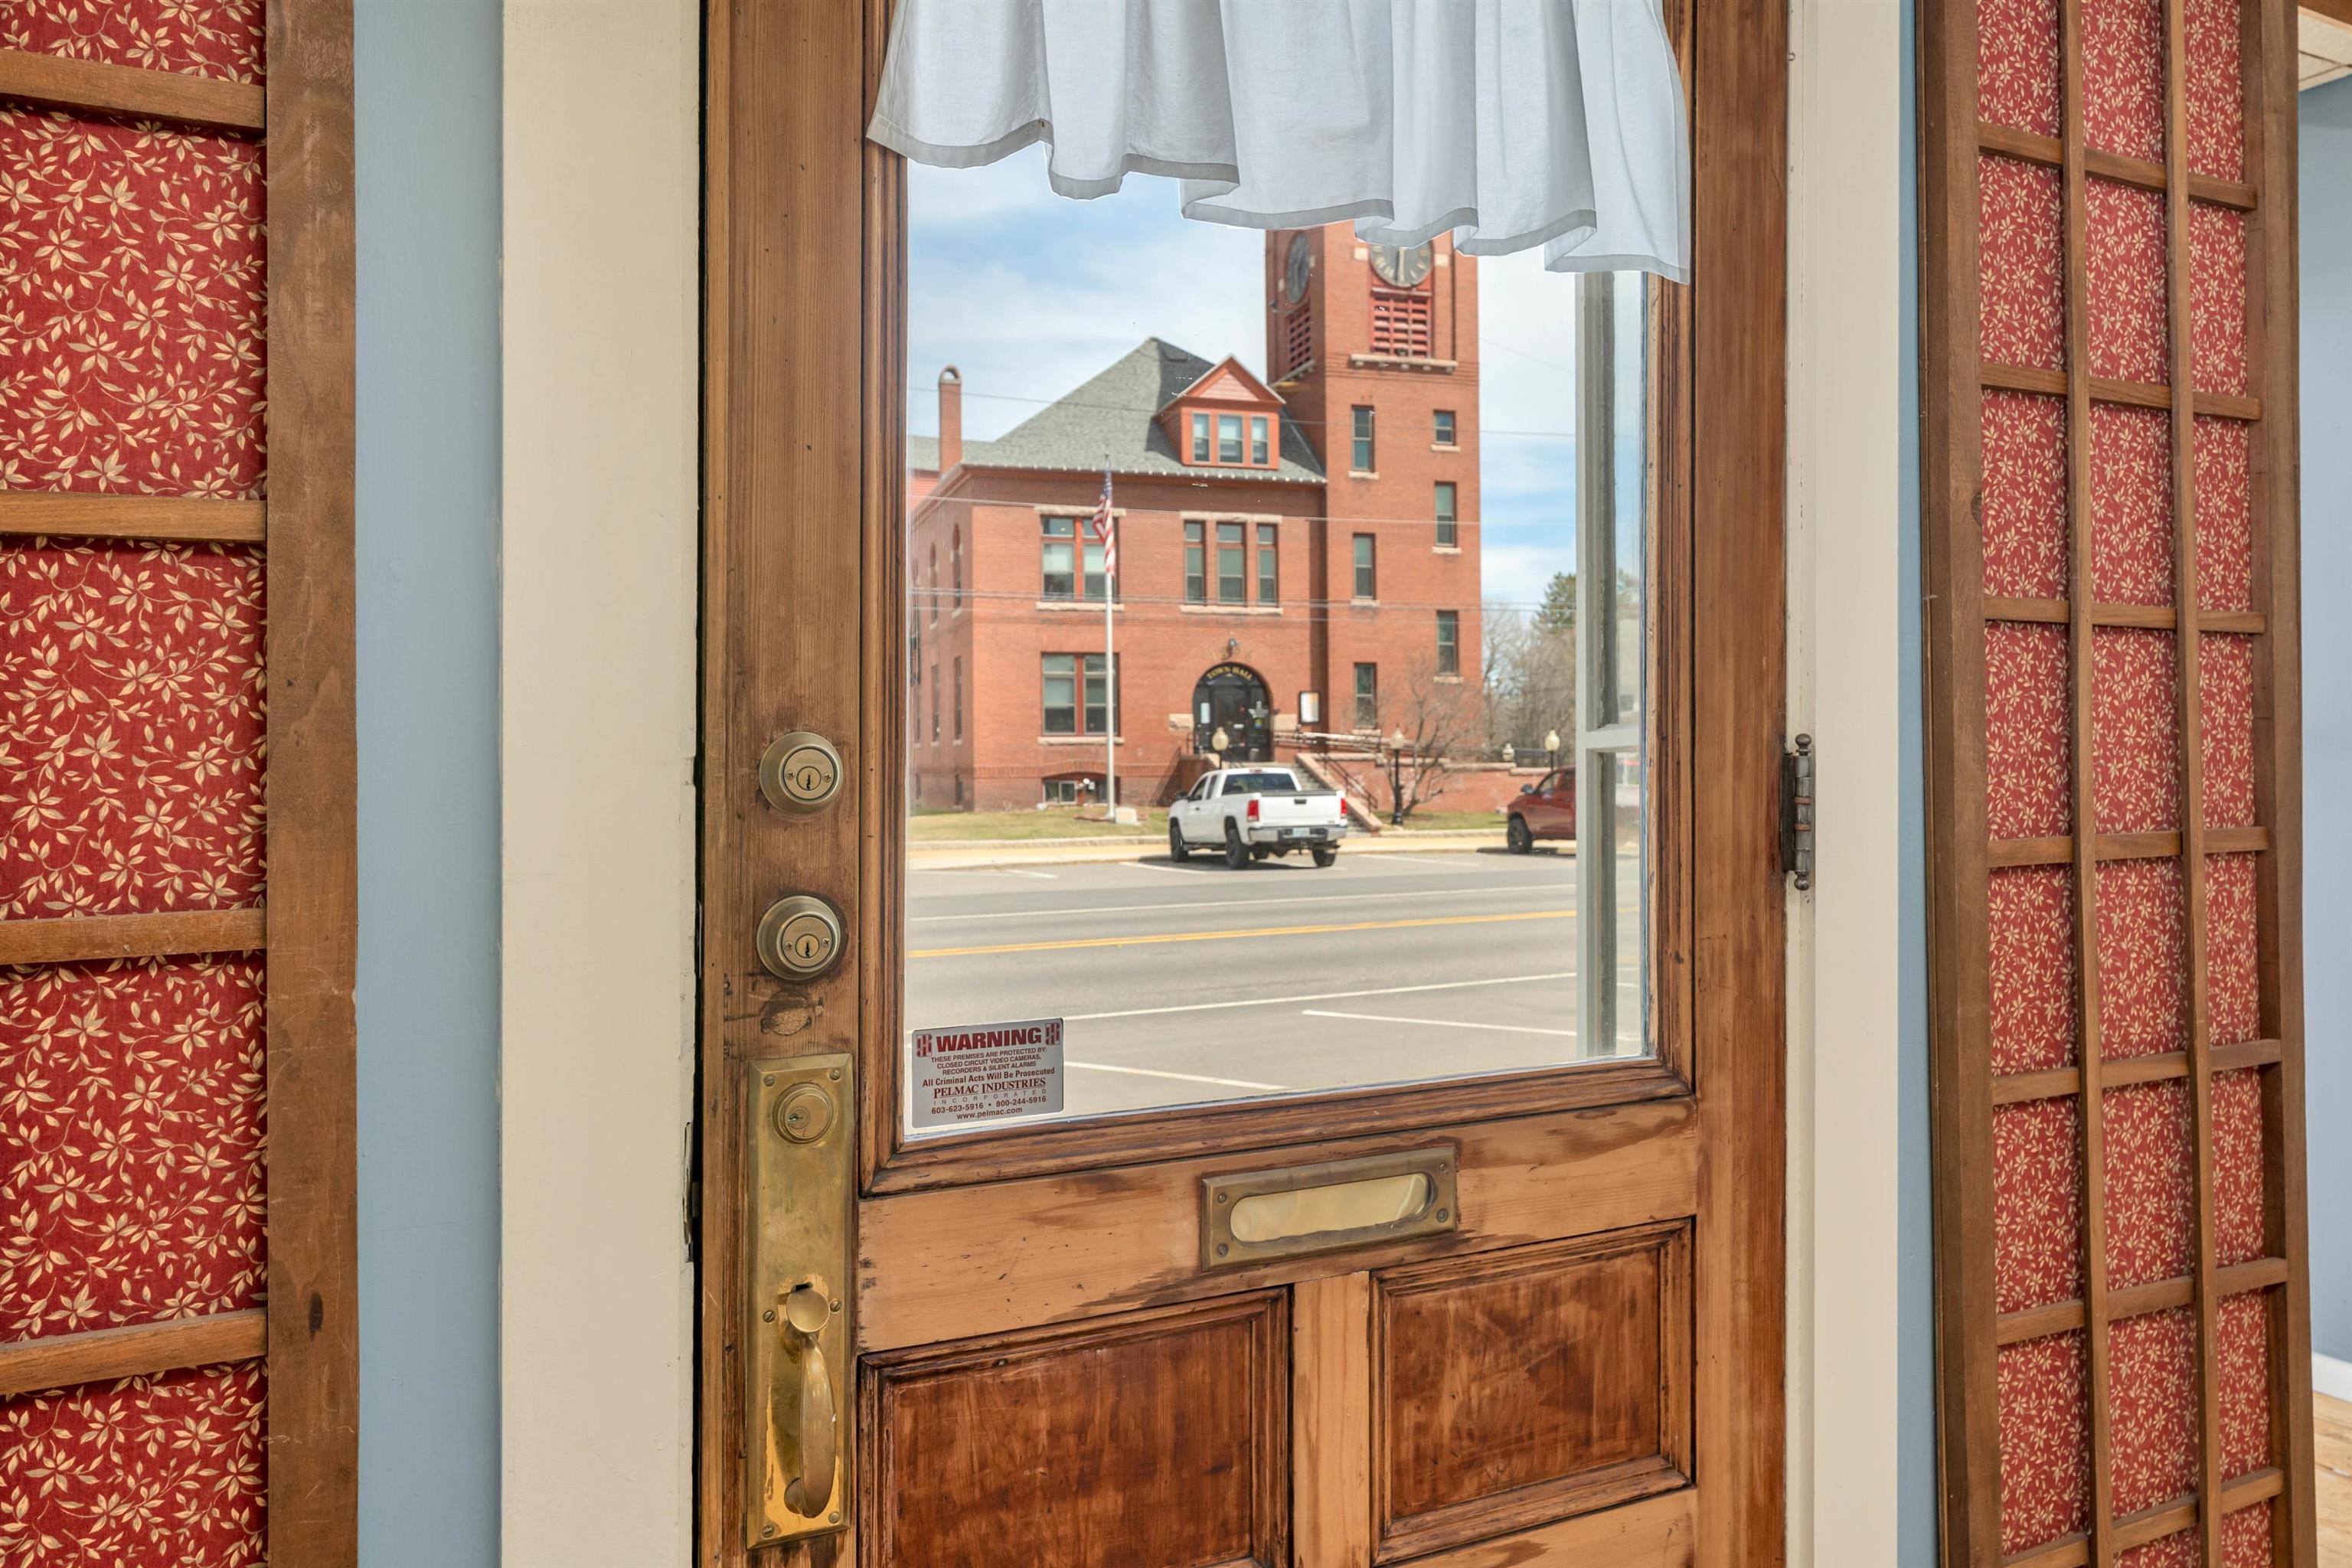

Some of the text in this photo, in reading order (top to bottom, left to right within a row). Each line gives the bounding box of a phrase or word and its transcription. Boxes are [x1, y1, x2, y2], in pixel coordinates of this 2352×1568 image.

[936, 1027, 1041, 1052] WARNING
[1000, 1047, 1036, 1056] PROTECTED
[923, 1079, 933, 1087] All
[936, 1076, 966, 1086] Criminal
[1015, 1067, 1055, 1077] Prosecuted
[942, 1067, 981, 1075] RECORDERS
[933, 1077, 1046, 1099] PELMAC INDUSTRIES
[932, 1096, 1047, 1114] 603-623-5916 800-244-5916
[957, 1107, 1022, 1119] www.pelmac.com
